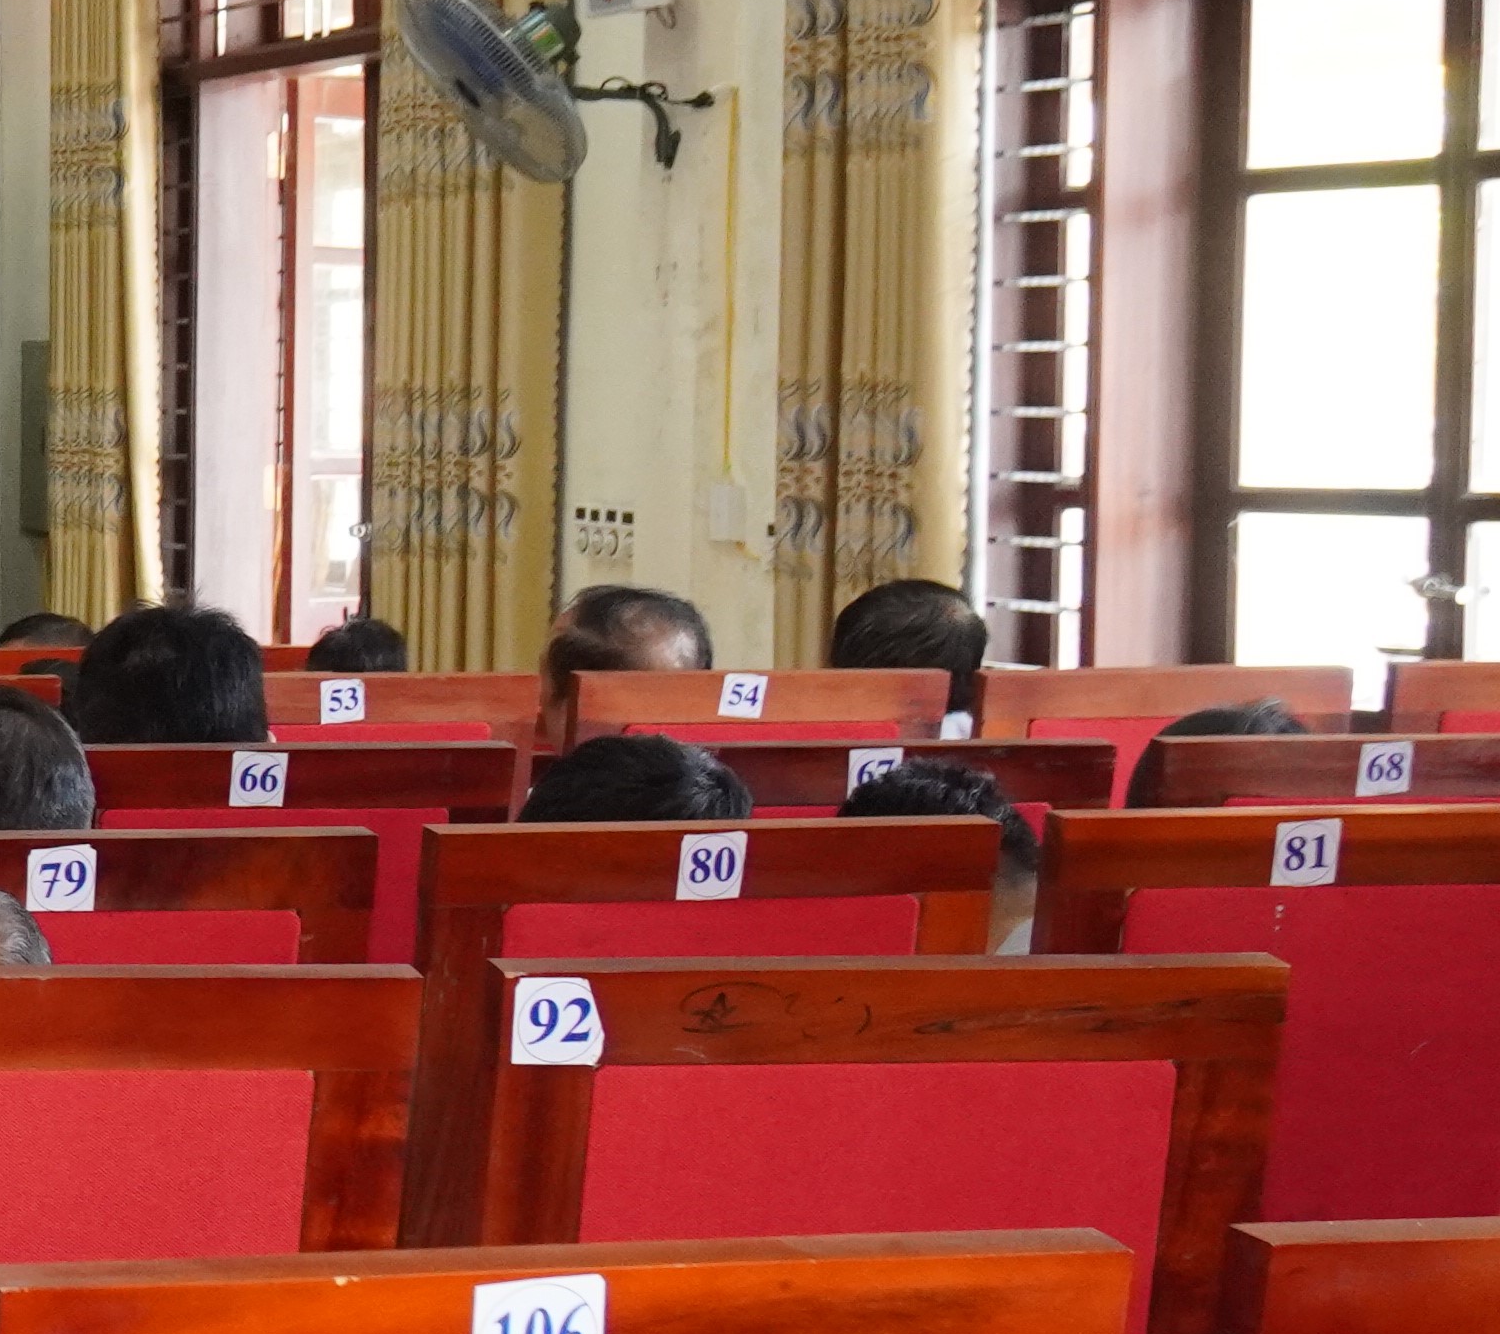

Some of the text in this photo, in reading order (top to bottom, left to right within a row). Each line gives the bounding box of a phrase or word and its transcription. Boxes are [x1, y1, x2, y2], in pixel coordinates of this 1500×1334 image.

[329, 686, 359, 713] 53
[728, 683, 759, 707] 54
[239, 763, 280, 793] 66
[1366, 752, 1405, 782] 68
[689, 846, 736, 884] 80
[1284, 834, 1327, 872] 81
[39, 860, 87, 898] 79
[529, 997, 592, 1044] 92
